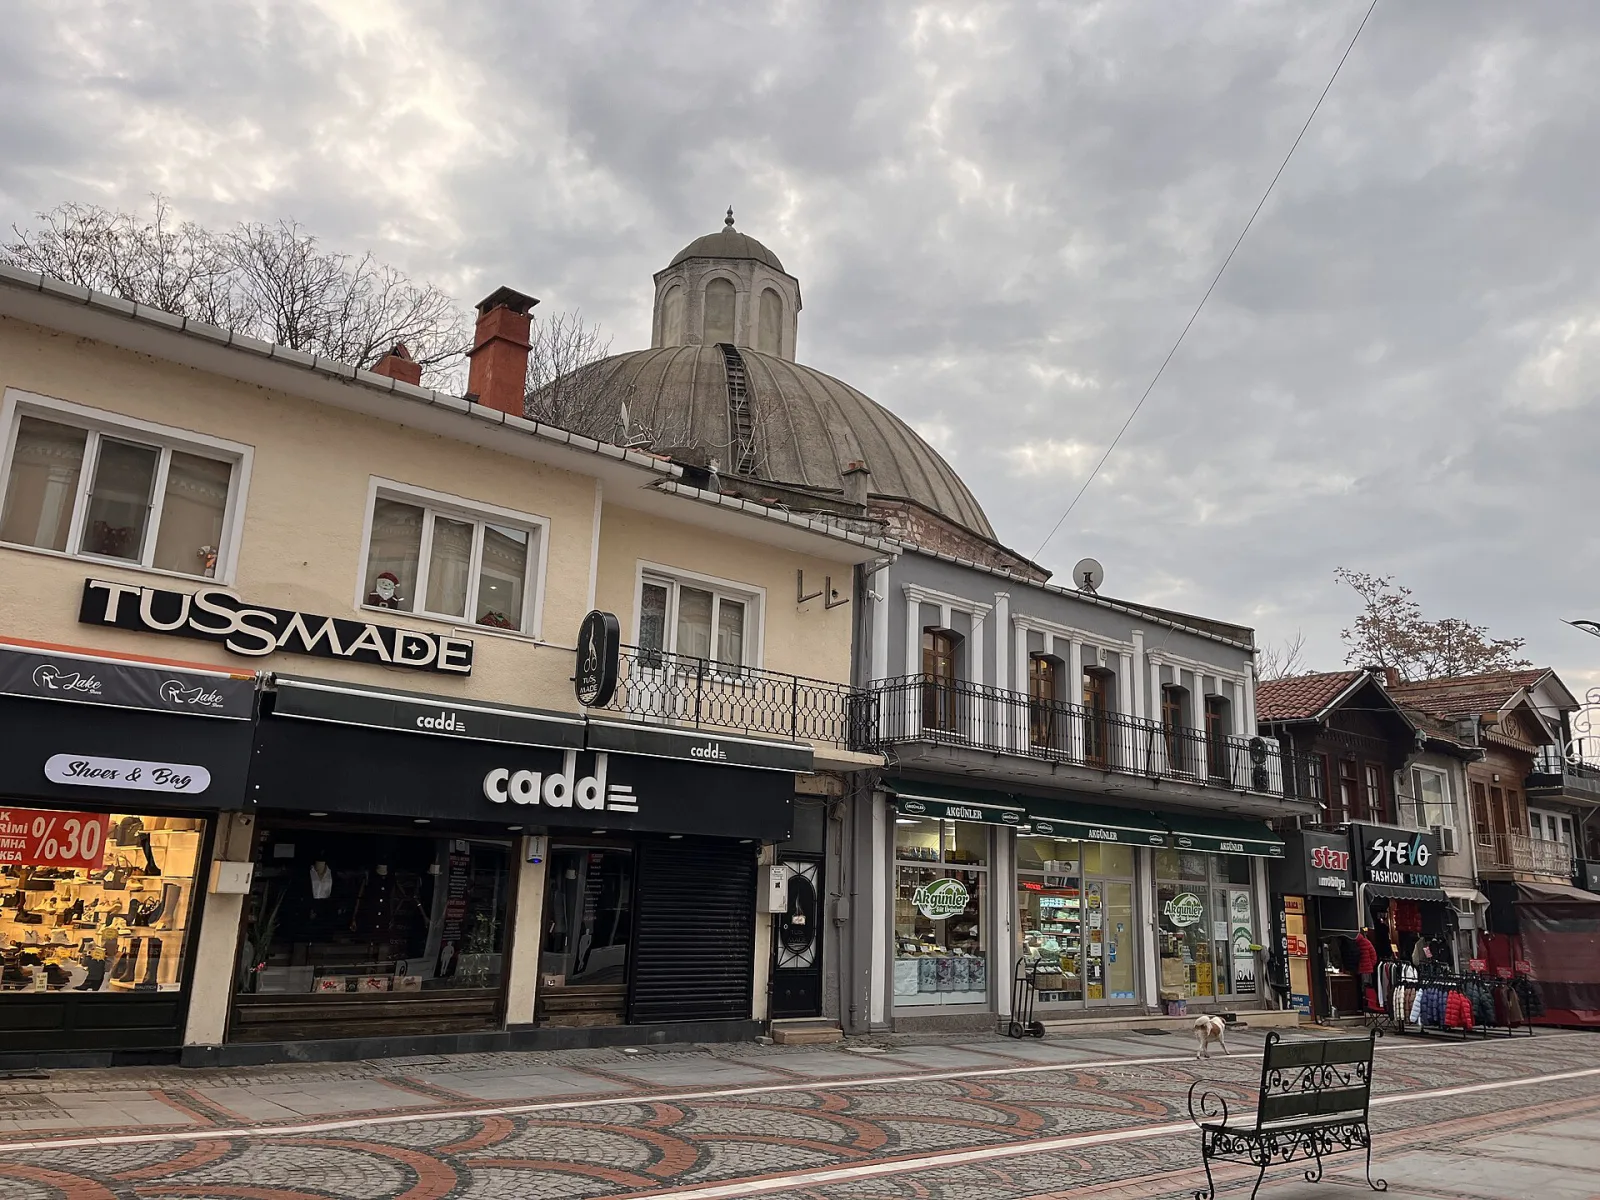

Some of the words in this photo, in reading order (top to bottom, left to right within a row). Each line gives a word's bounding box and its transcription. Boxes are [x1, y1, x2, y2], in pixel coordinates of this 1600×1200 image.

[580, 683, 598, 694] MADE
[62, 760, 120, 780] Shoes
[125, 767, 142, 782] &
[151, 767, 192, 790] Bag
[946, 806, 982, 820] AKGÜNLER
[32, 816, 101, 860] %30
[1088, 829, 1118, 841] AKGÜNLER
[1311, 845, 1350, 872] star
[1370, 869, 1404, 884] FASHION
[1410, 873, 1437, 887] EXPORT
[912, 888, 969, 908] Akgünler
